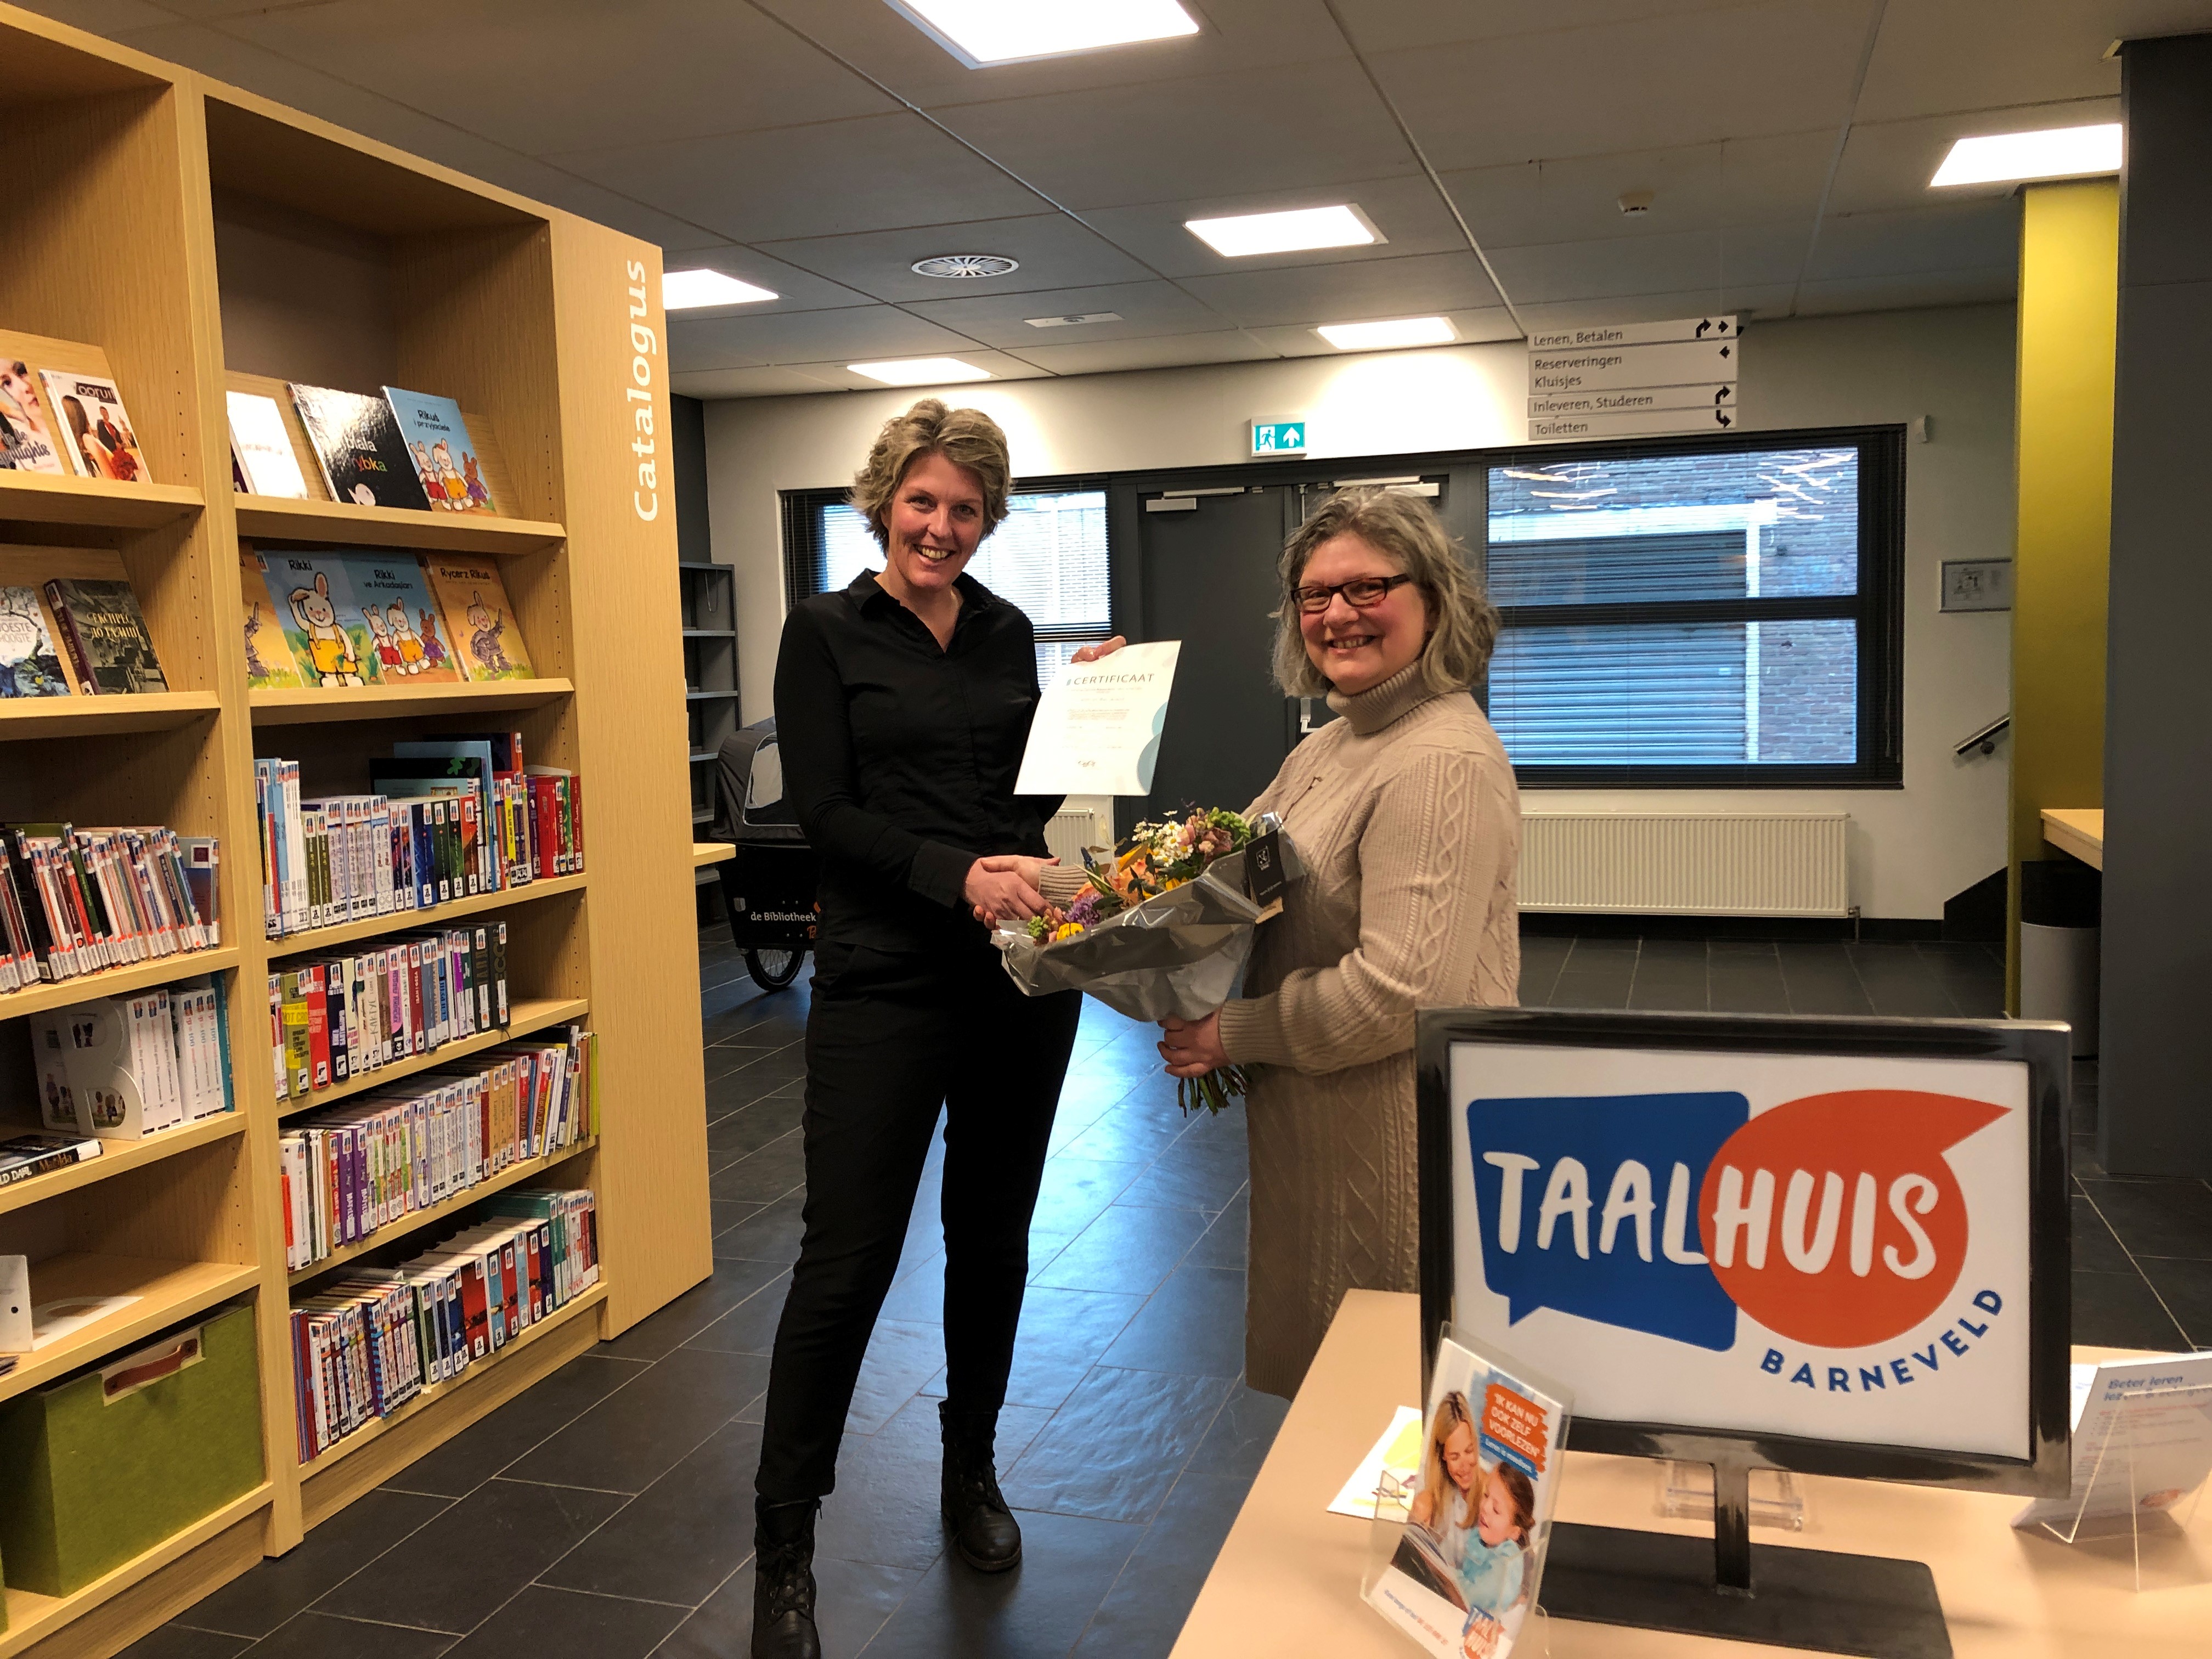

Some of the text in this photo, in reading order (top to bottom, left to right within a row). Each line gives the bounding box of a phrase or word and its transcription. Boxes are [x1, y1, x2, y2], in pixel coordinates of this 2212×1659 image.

[1534, 330, 1623, 347] Lenen, Betalen
[1534, 355, 1622, 371] Reserveringen
[1535, 374, 1582, 390] Kluisjes
[627, 259, 658, 522] Catalogus
[1534, 394, 1654, 414] Inleveren, Studeren
[1534, 422, 1588, 435] Toiletten
[288, 559, 313, 572] Rikki
[440, 567, 469, 580] Rycerz
[374, 568, 396, 580] Rikki
[1074, 673, 1155, 685] CERTIFICAAT
[751, 911, 817, 922] de Bibliotheek
[11, 1166, 32, 1181] DAHL
[1482, 1150, 1939, 1281] TAALHUIS
[1759, 1288, 2004, 1393] BARNEVELD
[2108, 1375, 2184, 1389] Beter leren
[1491, 1406, 1532, 1437] OOK ZELF
[1505, 1400, 1525, 1419] KAN
[1525, 1412, 1538, 1427] NU
